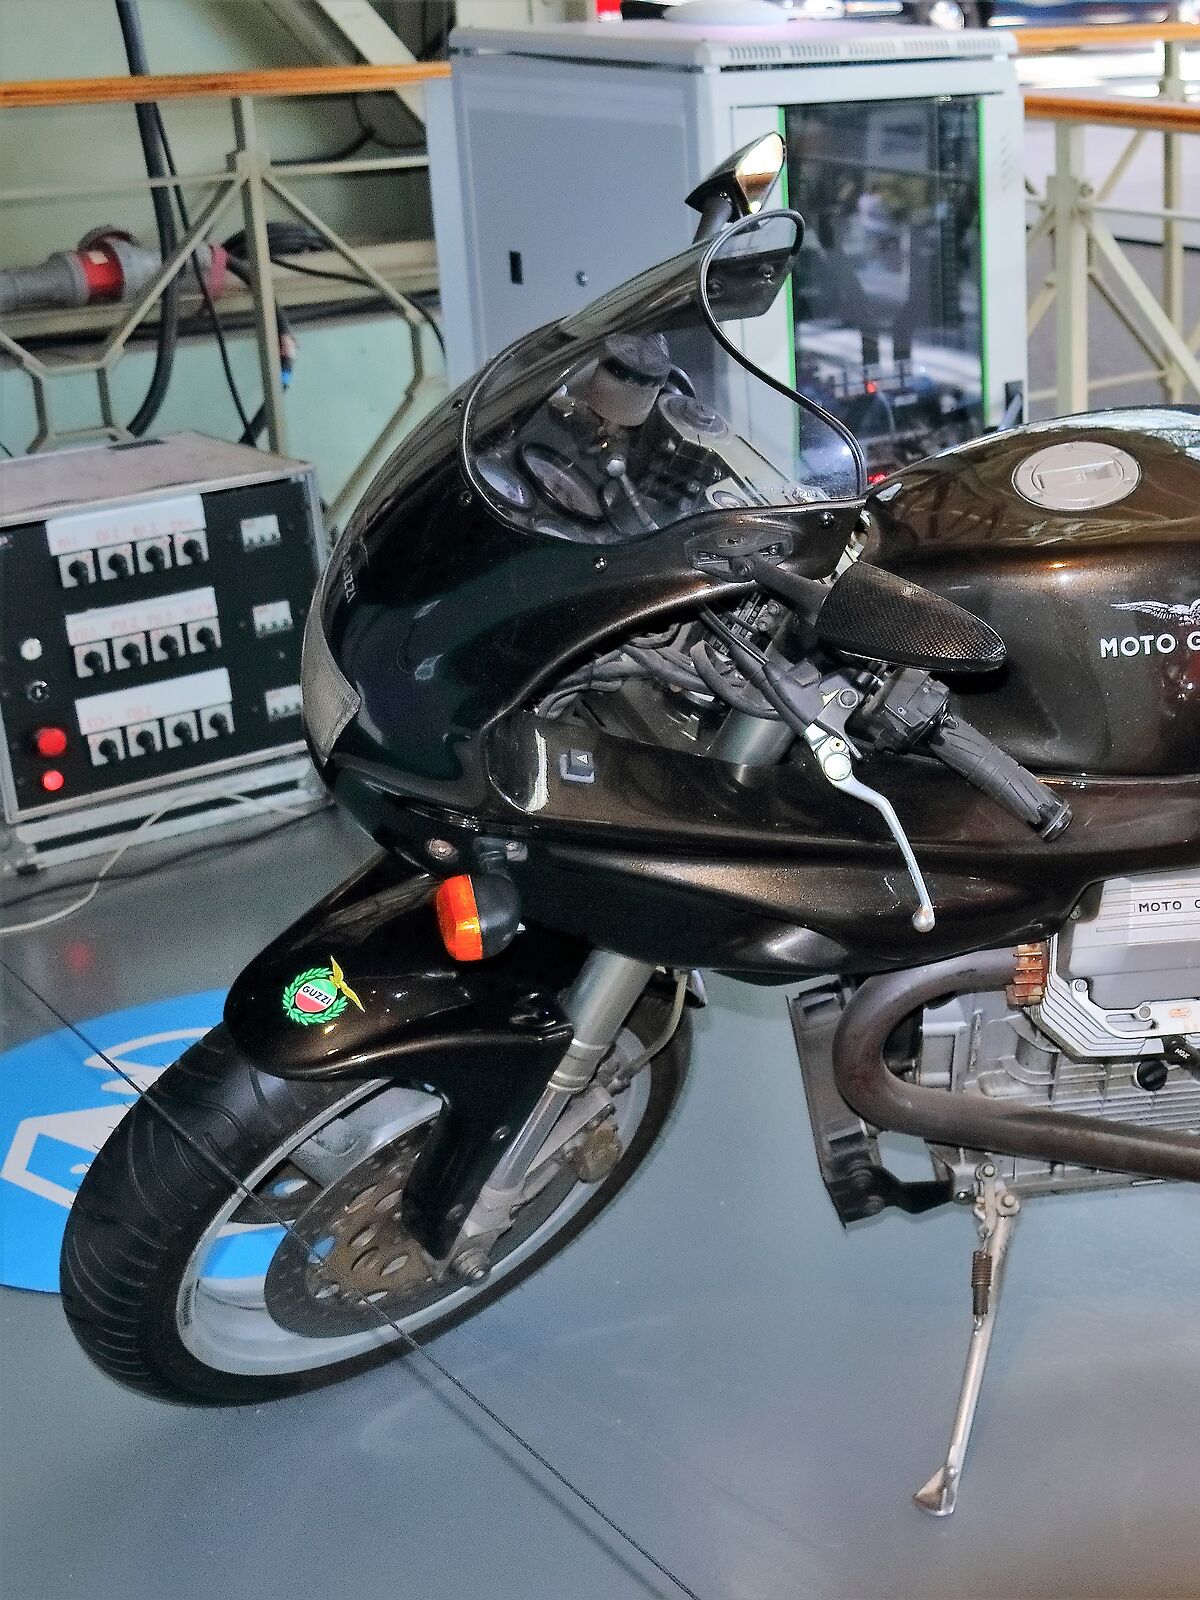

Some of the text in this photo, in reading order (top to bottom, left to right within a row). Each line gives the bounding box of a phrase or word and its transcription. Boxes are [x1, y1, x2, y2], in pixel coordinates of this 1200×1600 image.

[1099, 633, 1177, 659] MOTO
[1138, 900, 1182, 913] MOTO
[302, 985, 332, 1005] GUZZI
